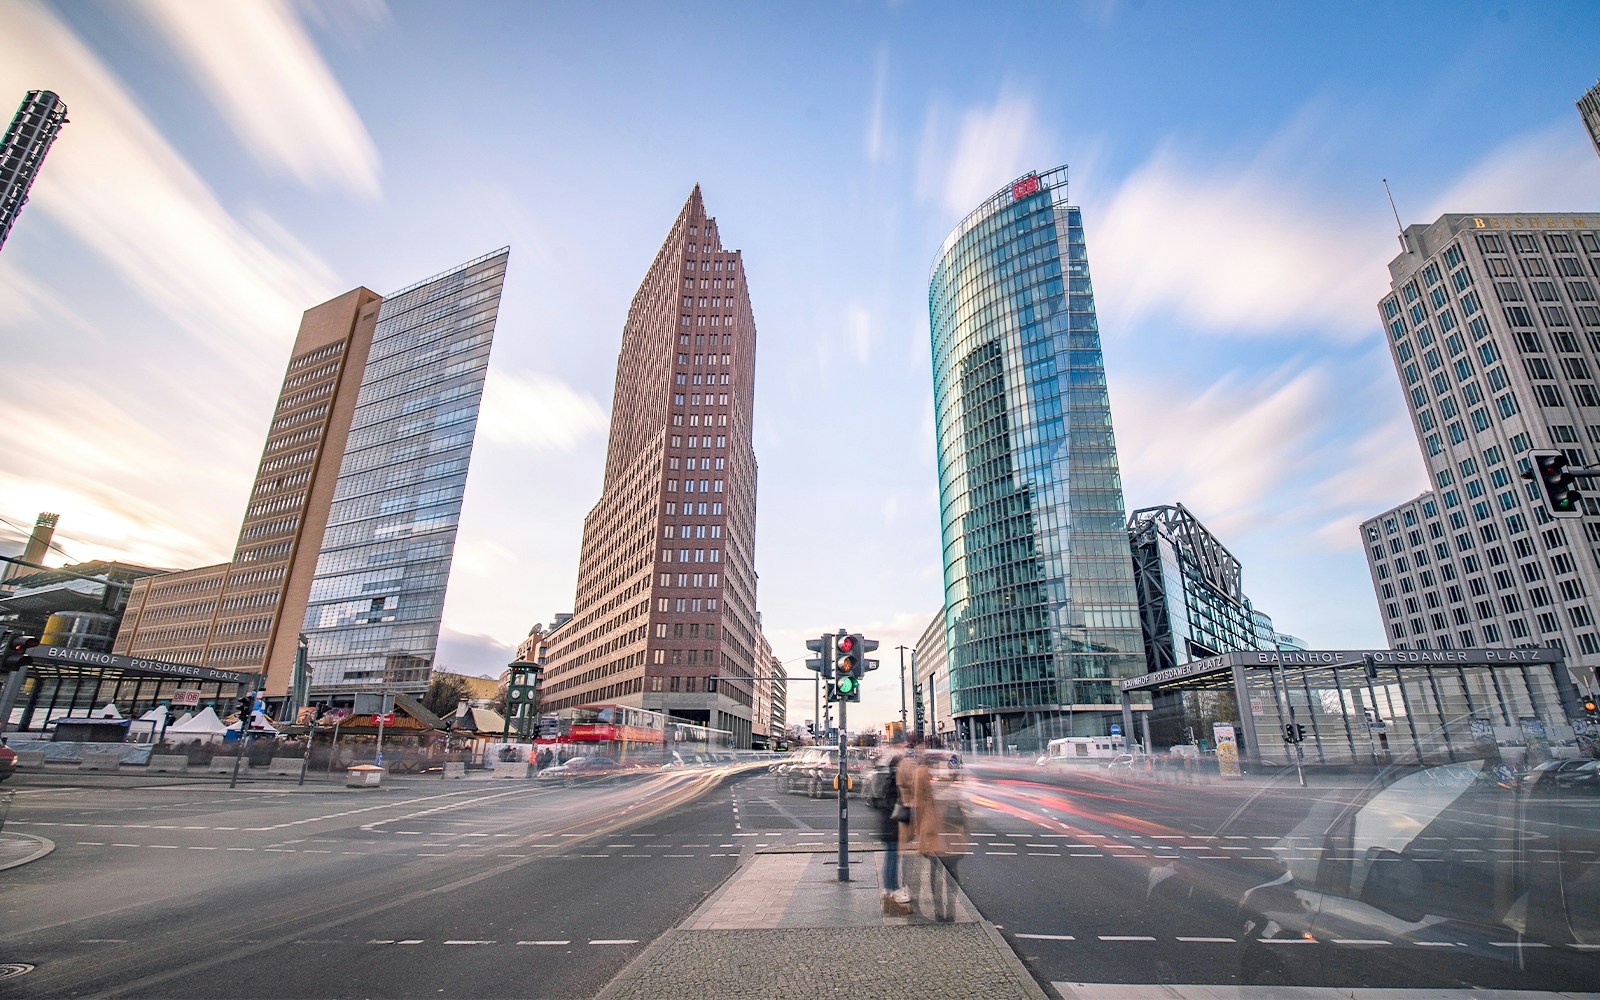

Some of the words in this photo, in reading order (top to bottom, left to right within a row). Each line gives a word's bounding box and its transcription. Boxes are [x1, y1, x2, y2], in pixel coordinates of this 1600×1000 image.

[1014, 177, 1038, 197] DB
[1473, 217, 1588, 229] BEISHEIM
[47, 647, 119, 665] BAHNHOF
[130, 659, 200, 676] POTSDAMER
[209, 669, 240, 681] PLATZ
[1258, 652, 1344, 663] BAHNHOF
[1485, 650, 1541, 660] PLATZ
[1124, 675, 1150, 688] BAHNHOF
[1153, 664, 1192, 682] POTSDAMER
[1197, 656, 1224, 671] PLATZ
